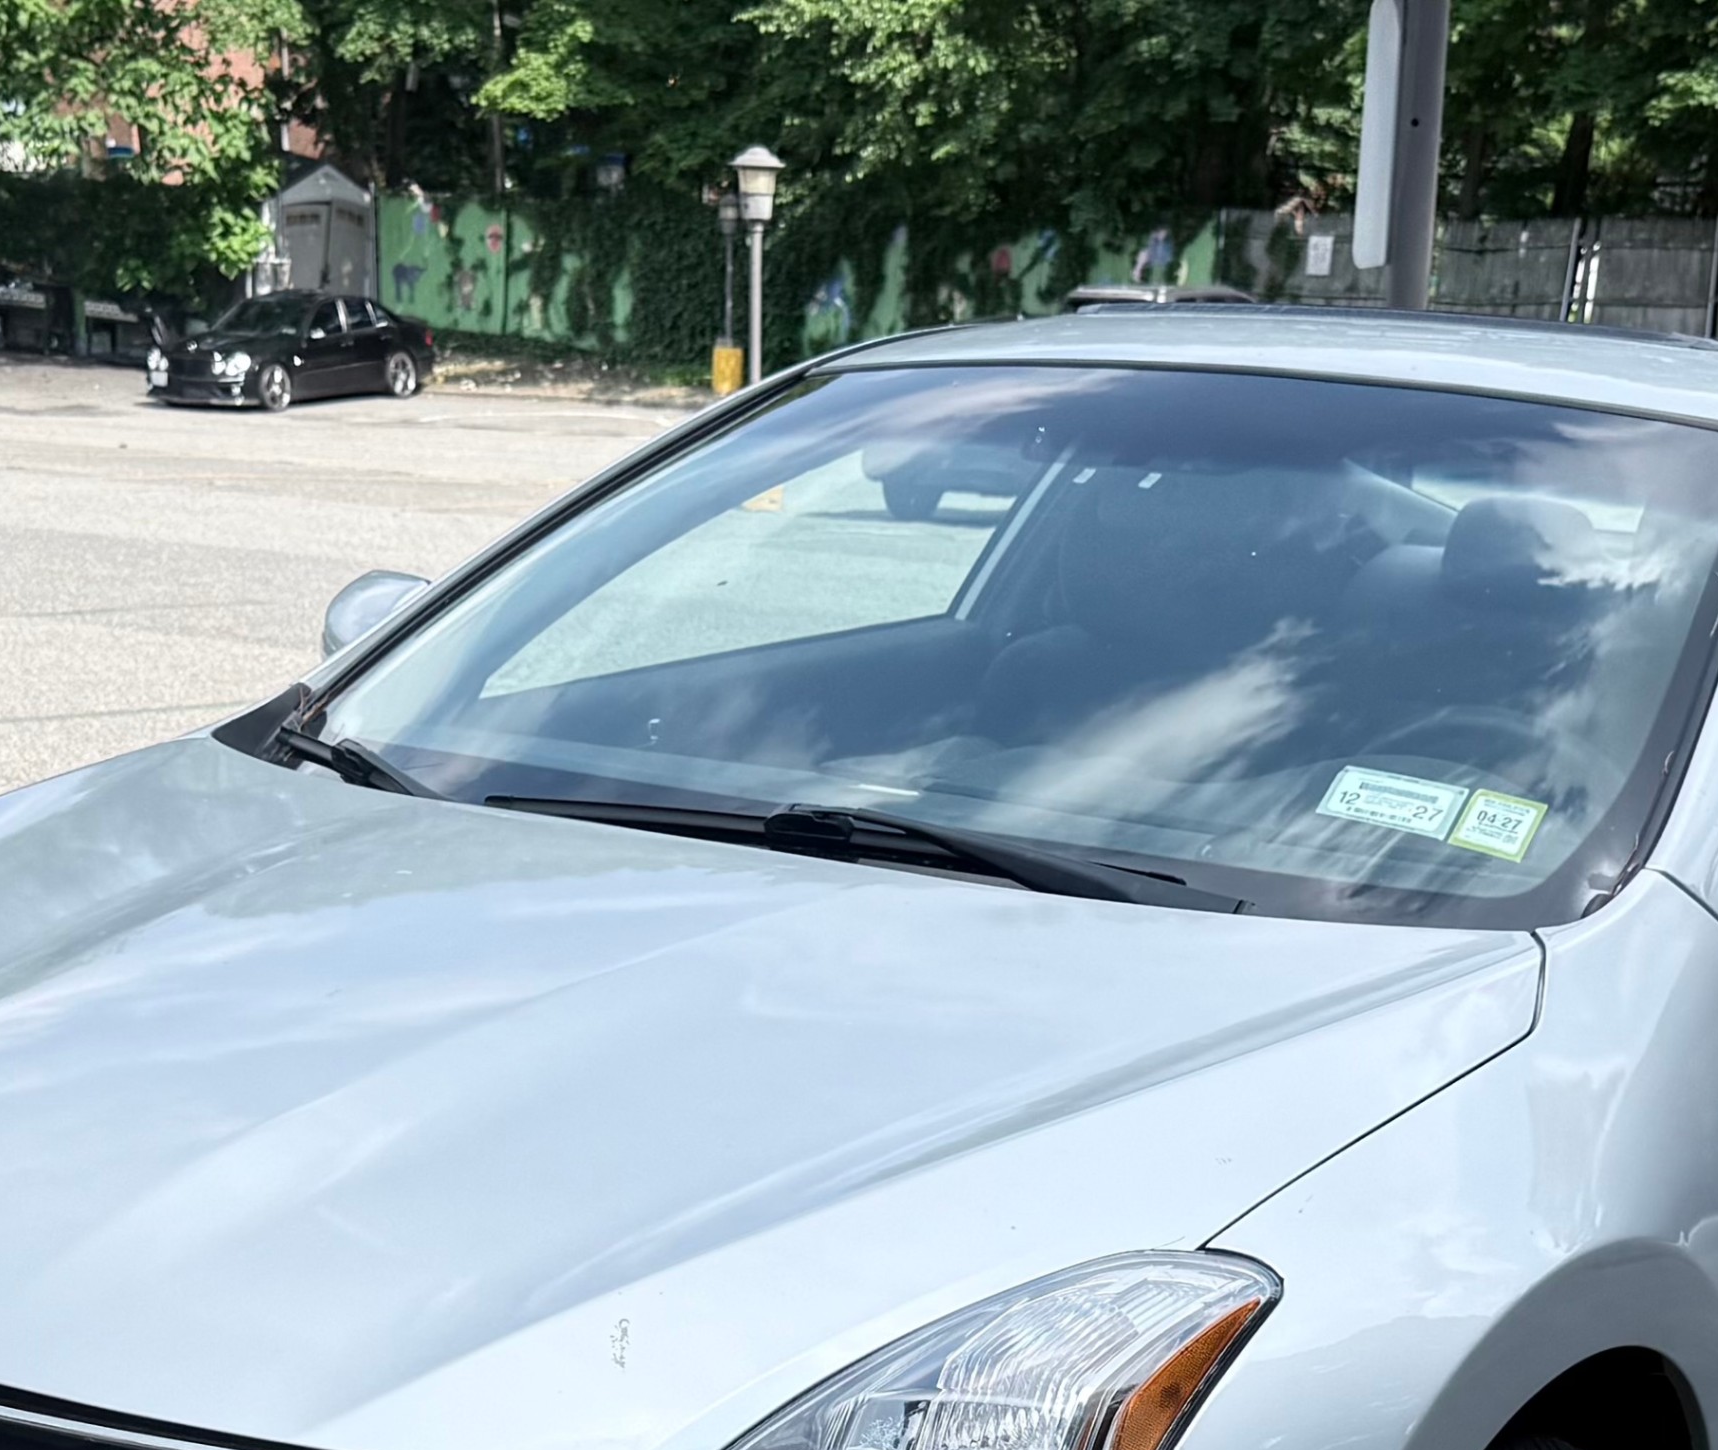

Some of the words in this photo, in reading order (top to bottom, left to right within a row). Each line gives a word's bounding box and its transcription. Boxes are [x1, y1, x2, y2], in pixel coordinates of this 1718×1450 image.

[1339, 790, 1361, 806] 12
[1412, 805, 1444, 822] 27
[1476, 810, 1497, 824] 04
[1500, 816, 1523, 831] 27
